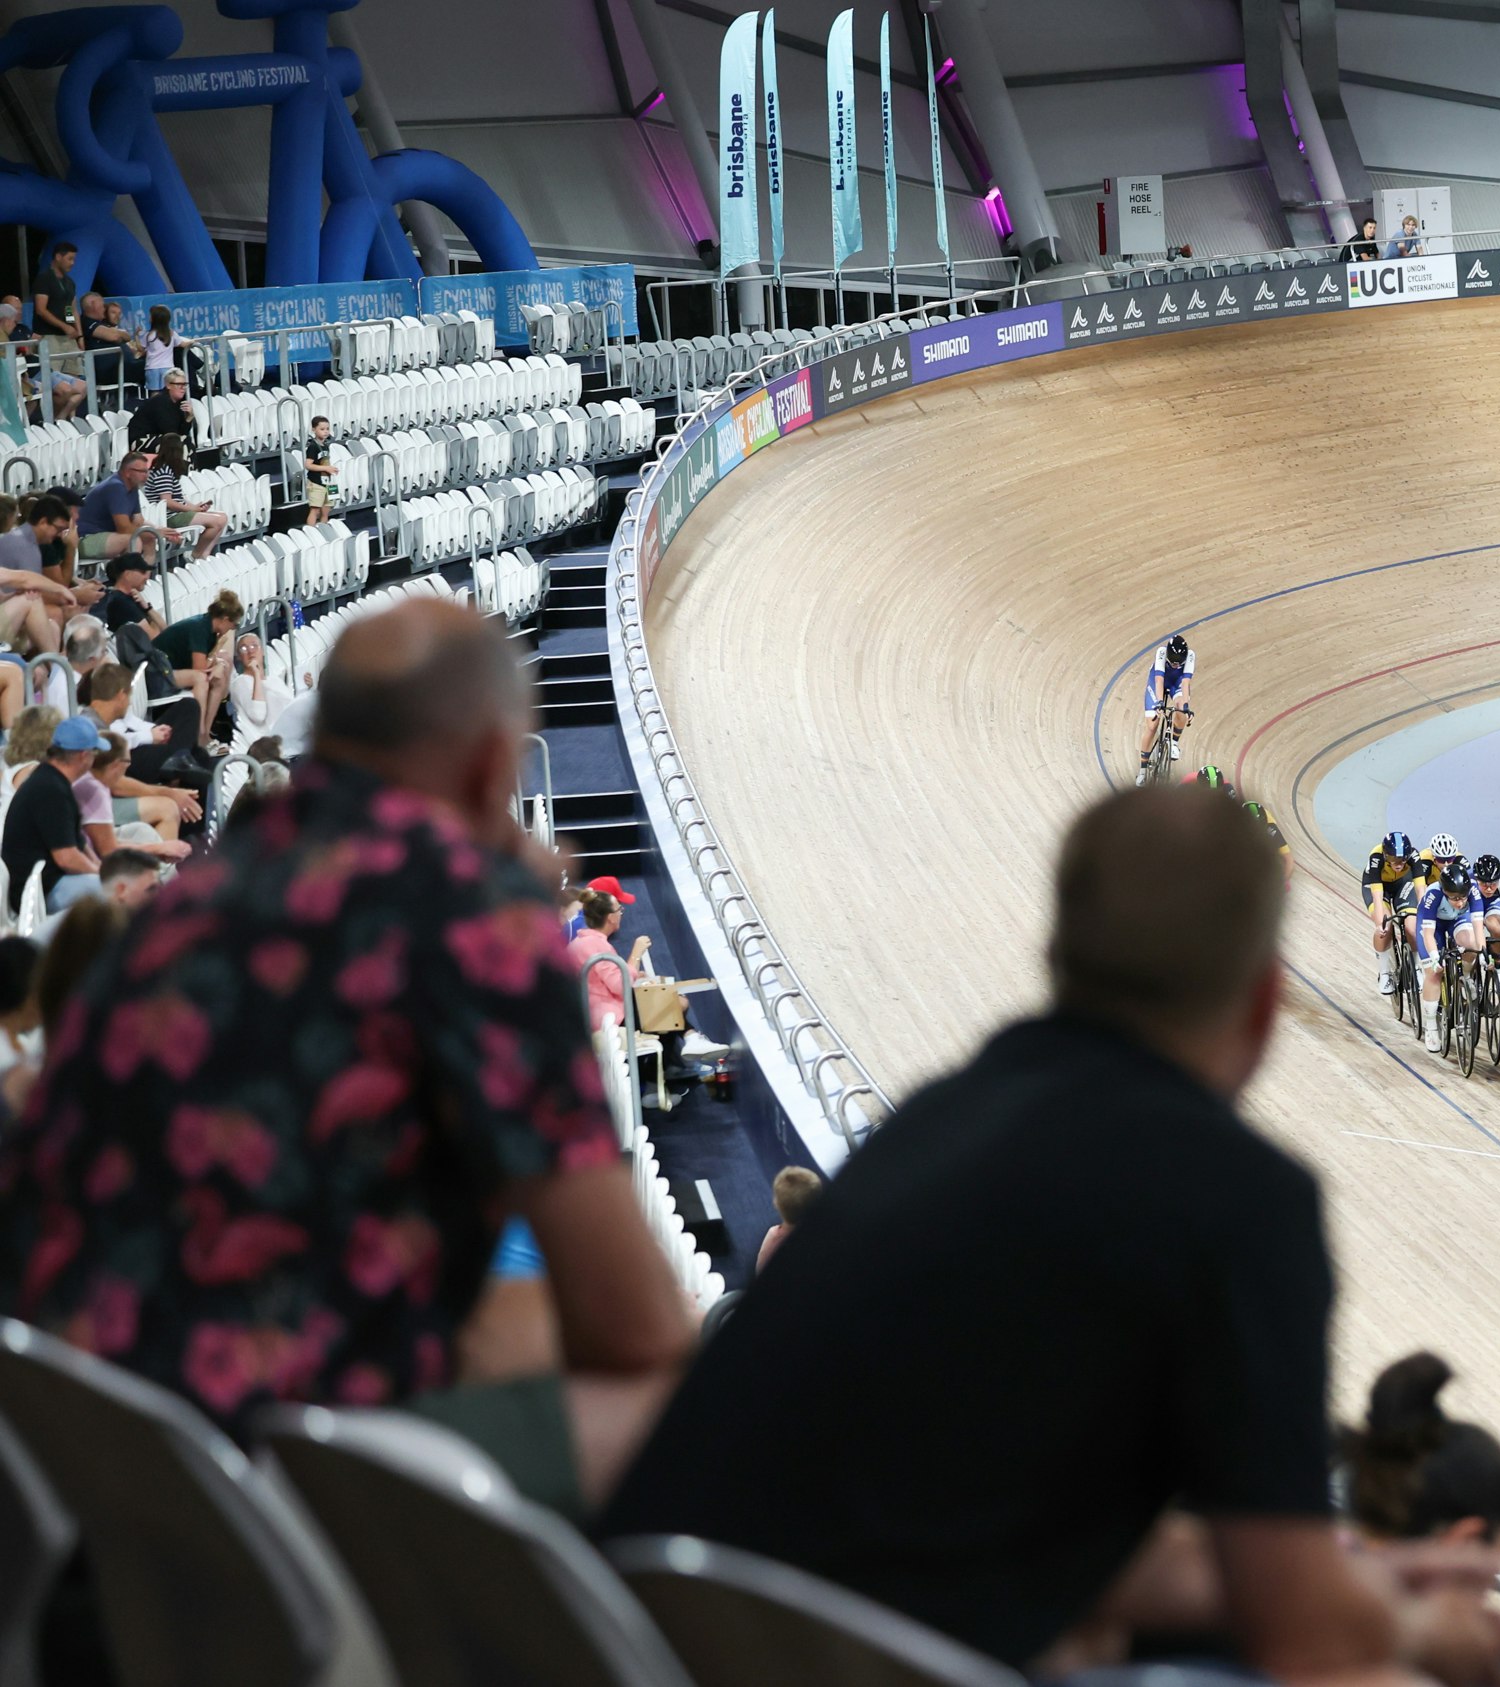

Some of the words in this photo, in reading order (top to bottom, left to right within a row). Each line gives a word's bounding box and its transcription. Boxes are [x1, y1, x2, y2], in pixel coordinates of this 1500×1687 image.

[153, 72, 208, 95] BRISBANE
[210, 69, 256, 92] CYCLING
[257, 65, 310, 88] FESTIVAL
[727, 94, 744, 198] brisbane
[1131, 183, 1149, 191] FIRE
[1129, 194, 1152, 203] HOSE
[1131, 206, 1152, 214] REEL
[1407, 264, 1426, 273] UNION
[1359, 267, 1404, 298] UCI
[1407, 273, 1433, 283] CYCLISTE
[1408, 281, 1455, 293] INTERNATIONALE
[265, 297, 327, 327] CYCLING
[348, 292, 404, 320] CYCLING
[173, 304, 240, 333] CYCLING
[997, 319, 1048, 347] SHIMANO
[923, 335, 970, 364] SHIMANO
[746, 396, 775, 445] CYCLING
[775, 379, 811, 427] FESTIVAL
[1371, 857, 1380, 868] WA
[1410, 850, 1420, 863] WA
[1459, 857, 1470, 869] WA
[1424, 892, 1436, 910] NSW
[1471, 885, 1481, 901] NSW
